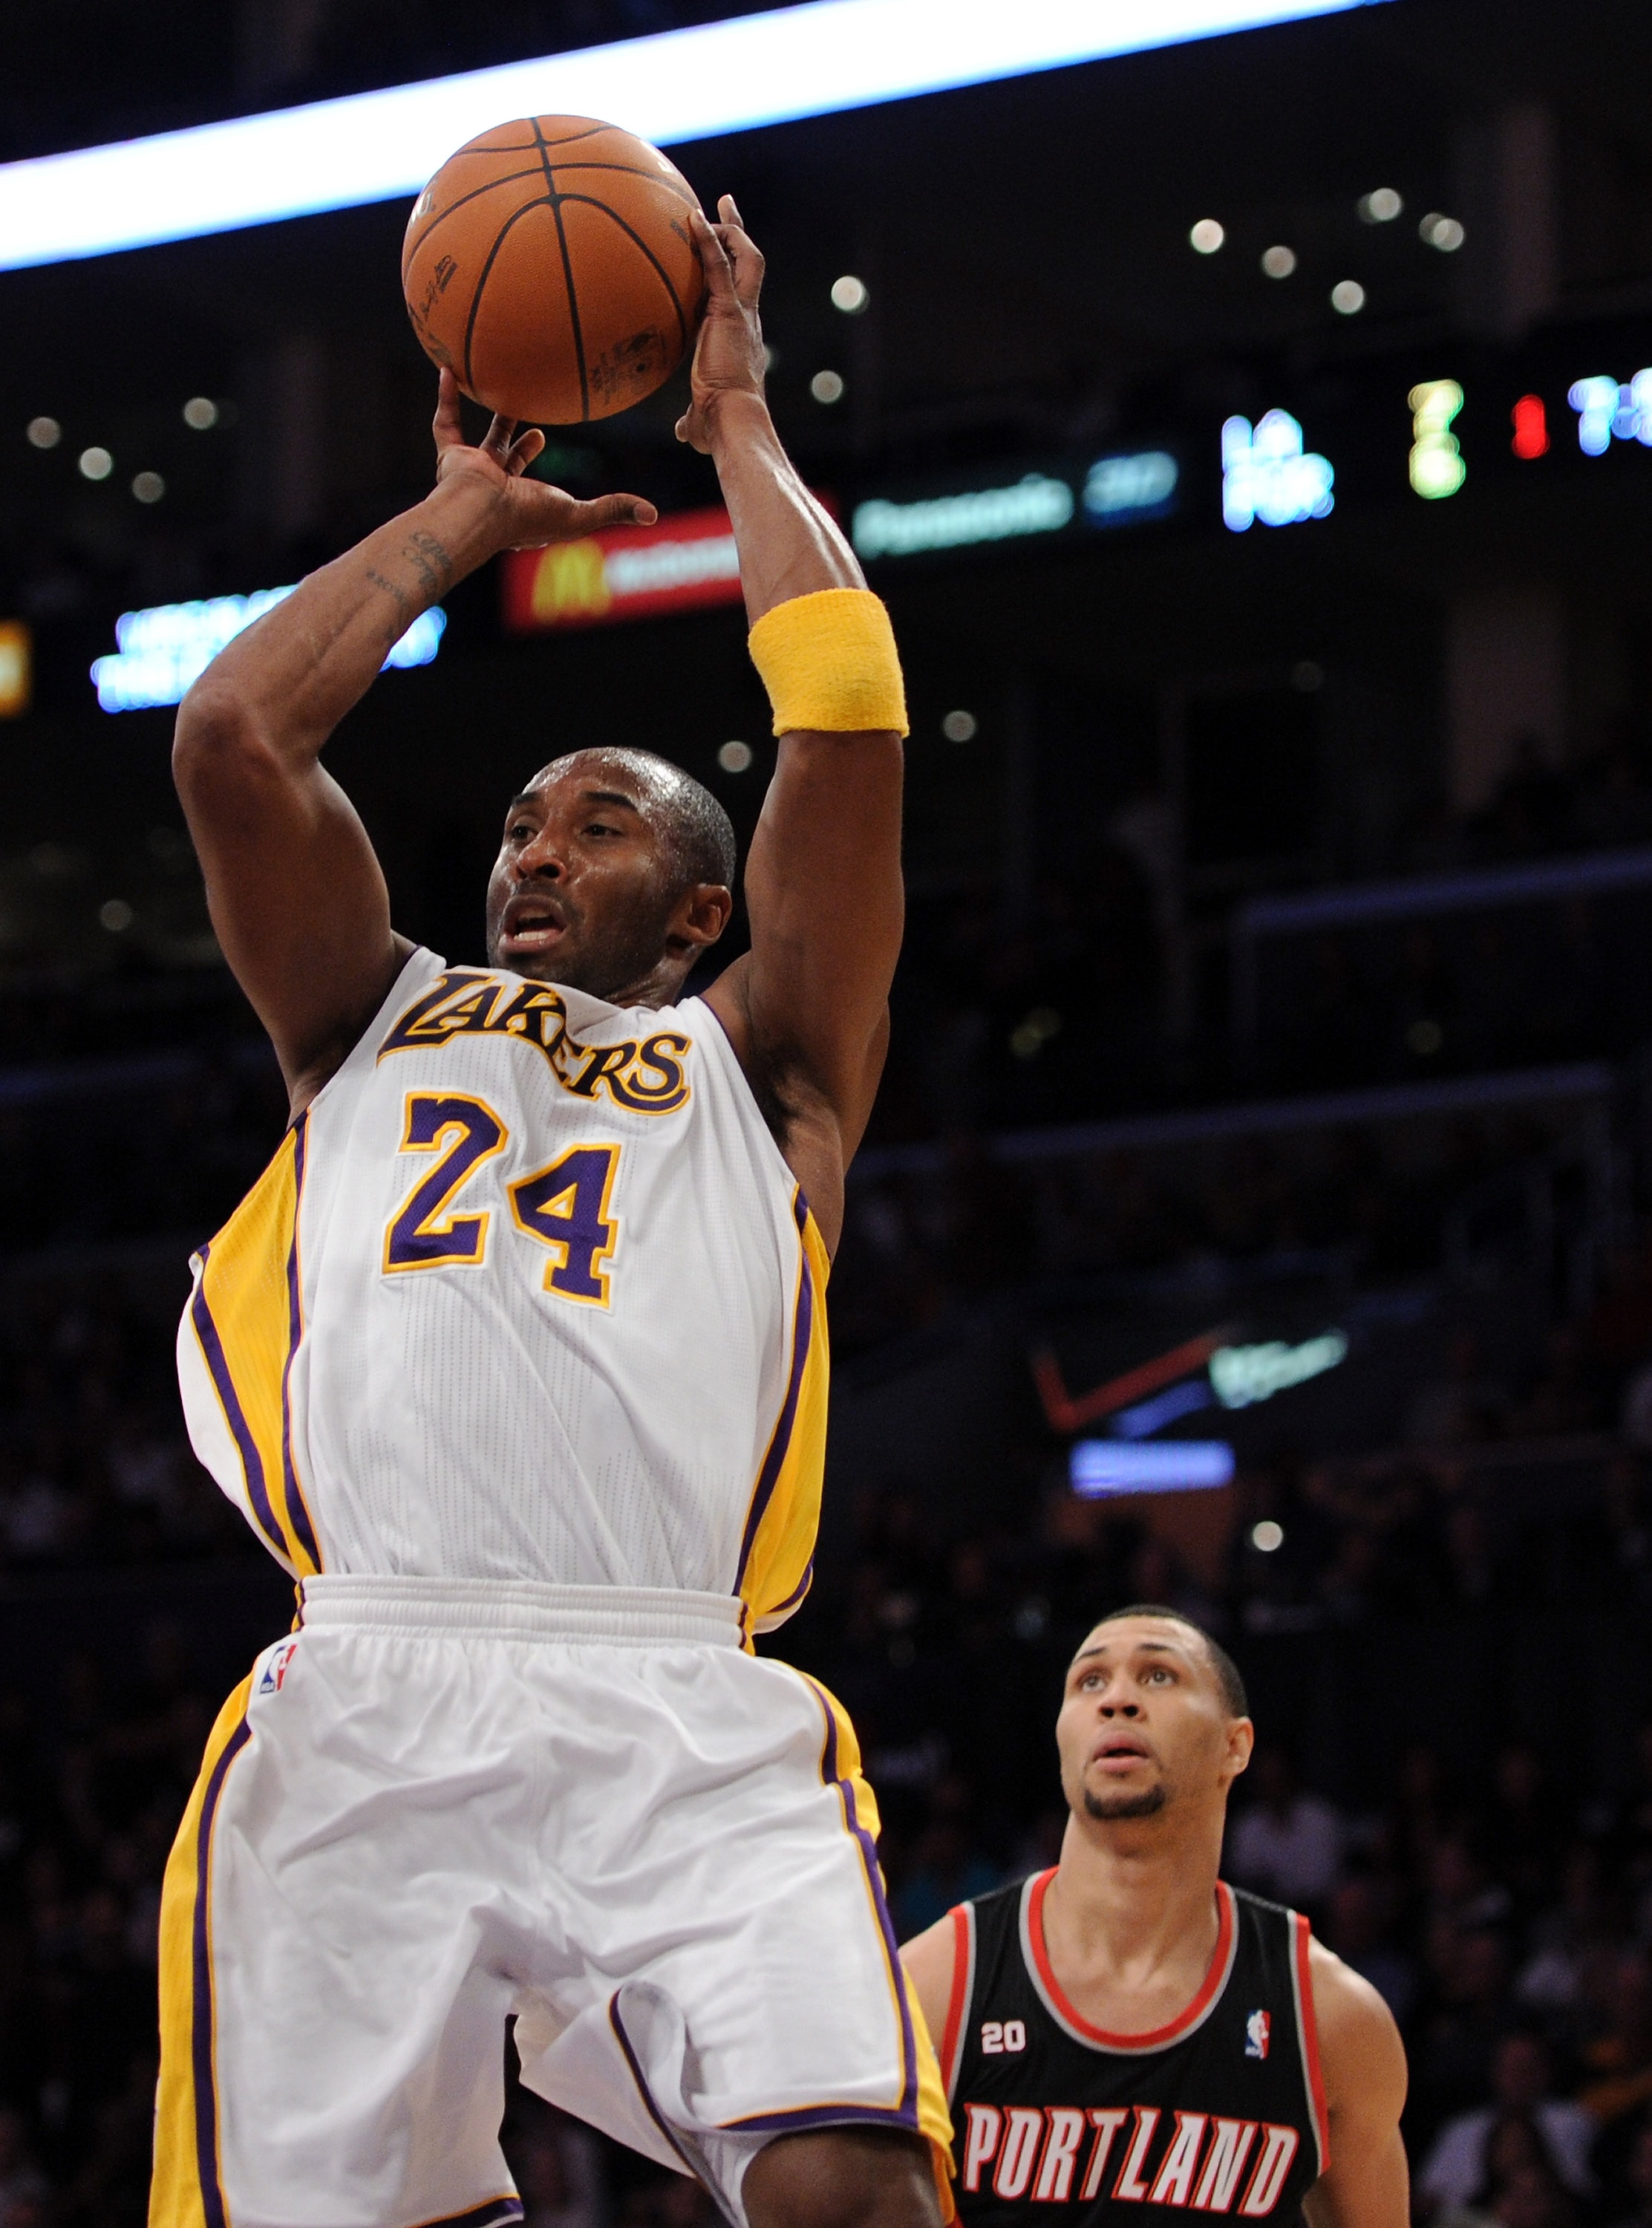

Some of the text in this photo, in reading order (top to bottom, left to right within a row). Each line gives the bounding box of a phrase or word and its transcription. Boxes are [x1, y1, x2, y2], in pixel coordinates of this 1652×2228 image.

[382, 1092, 621, 1309] 24
[981, 2020, 1026, 2054] 20
[963, 2102, 1299, 2217] PORTLAND
